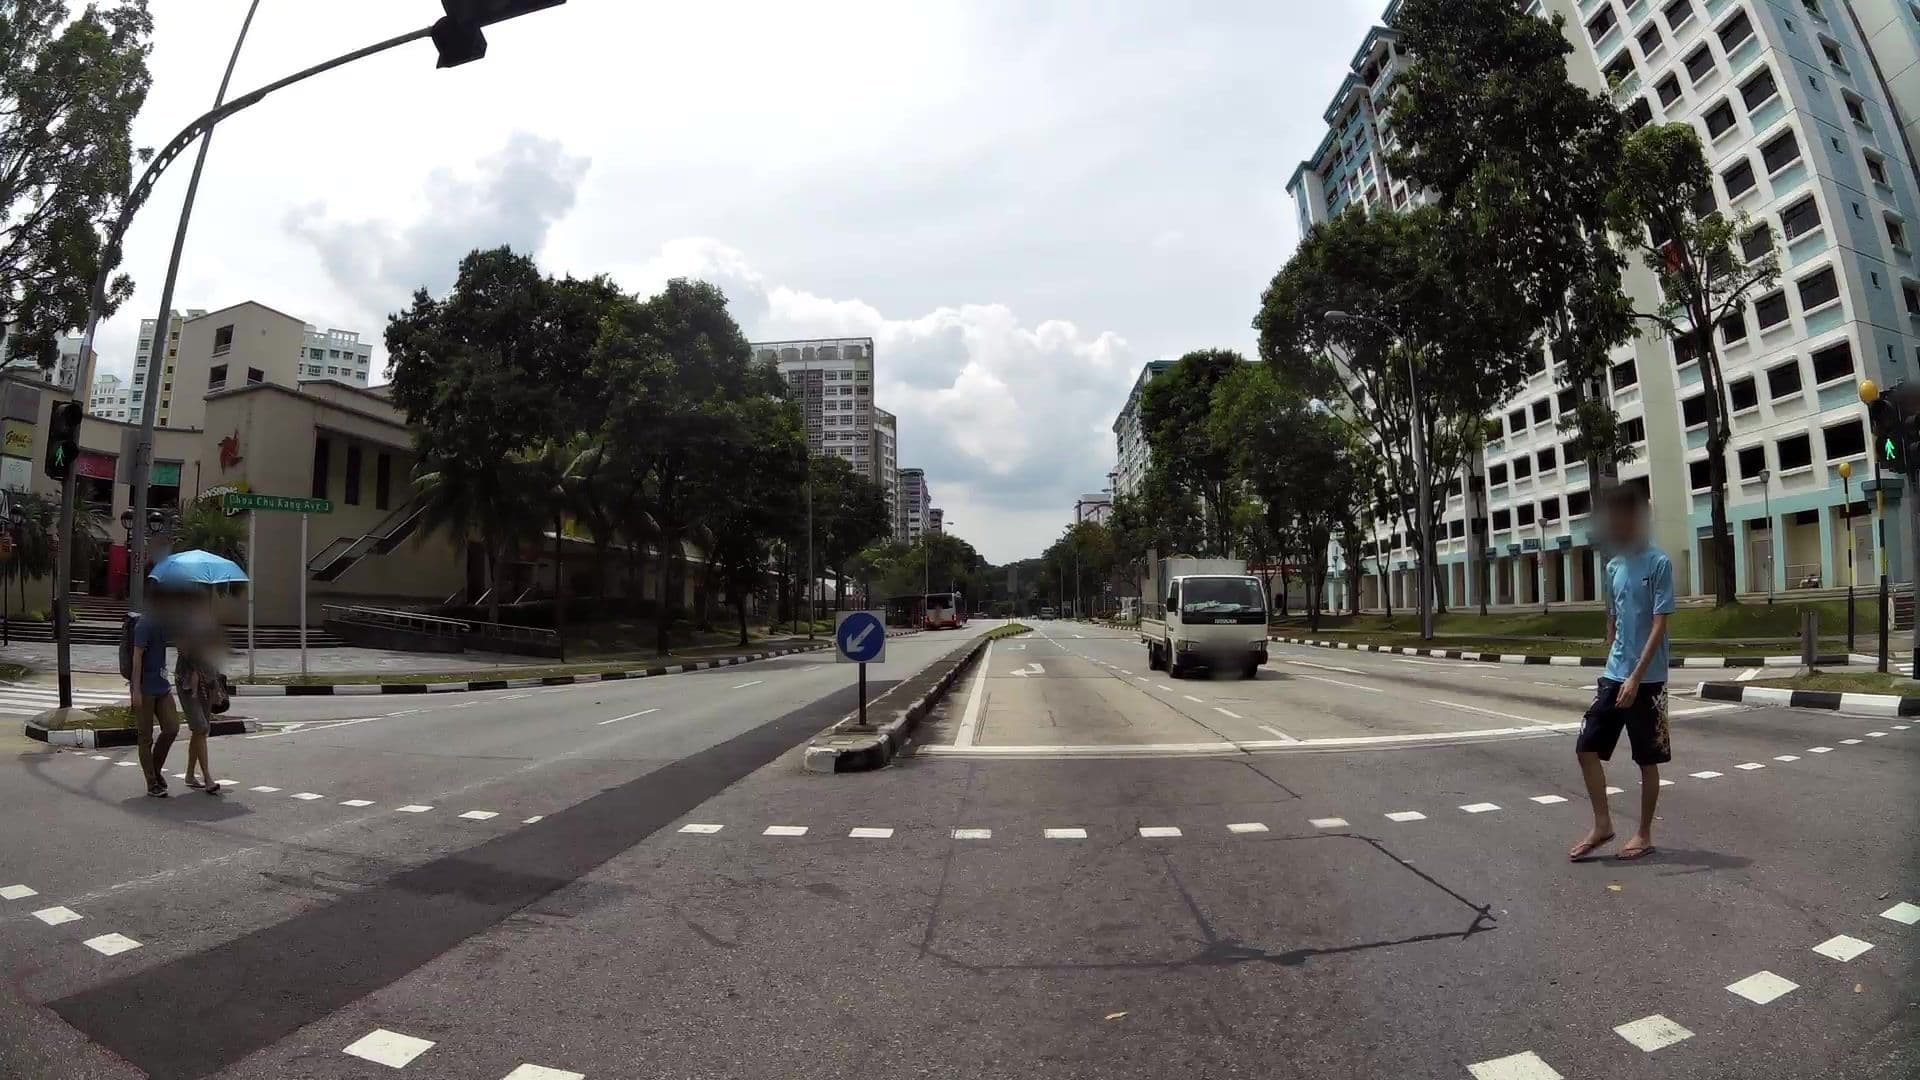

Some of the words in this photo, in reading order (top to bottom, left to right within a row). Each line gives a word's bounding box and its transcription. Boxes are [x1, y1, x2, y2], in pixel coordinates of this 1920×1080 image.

[229, 494, 253, 505] Choa
[256, 496, 274, 507] Chu
[277, 499, 301, 511] Kang
[303, 500, 320, 510] Ave
